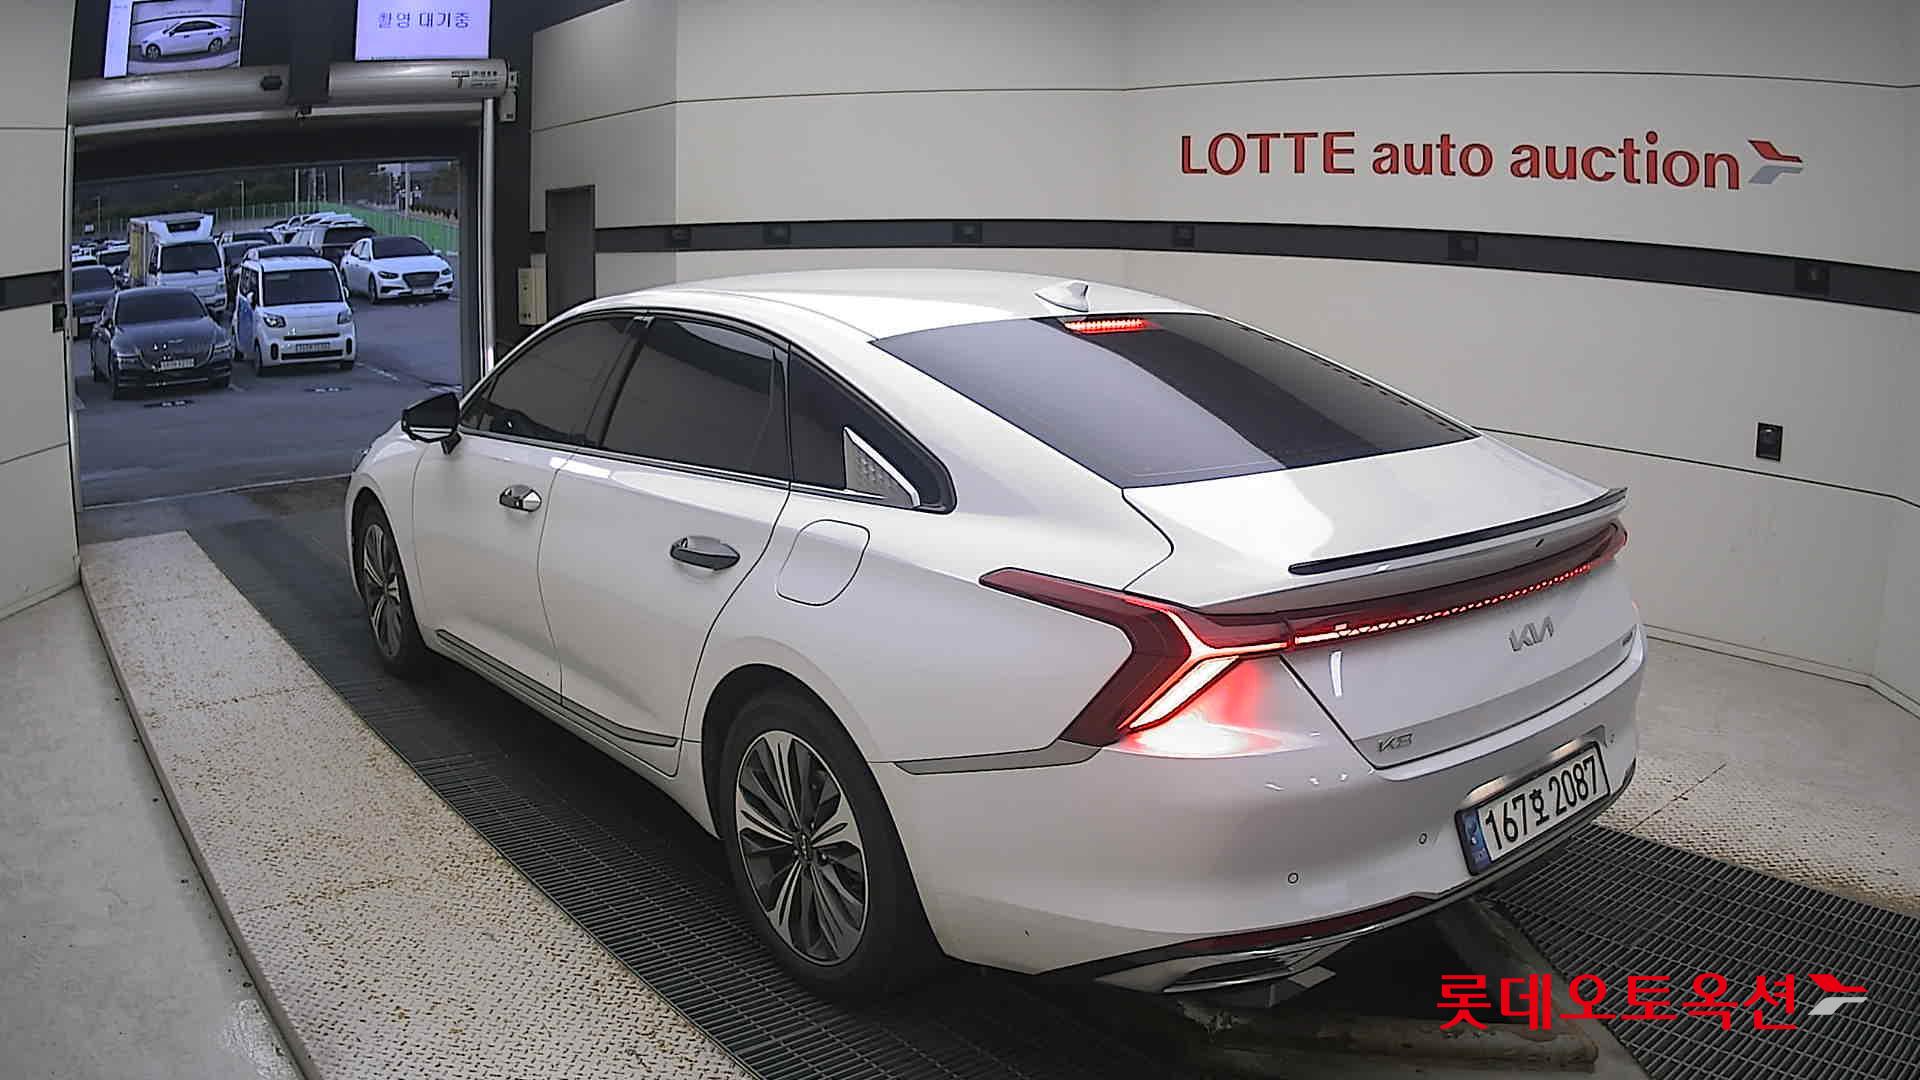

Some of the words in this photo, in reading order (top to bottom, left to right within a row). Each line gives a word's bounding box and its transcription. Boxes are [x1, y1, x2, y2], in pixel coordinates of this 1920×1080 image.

[418, 11, 471, 29] 대기중
[1180, 130, 1356, 176] LOTTE
[1372, 133, 1494, 178] auto
[1509, 130, 1741, 190] auction
[1377, 732, 1414, 754] K8
[1484, 788, 1551, 851] 167호
[1548, 757, 1600, 815] 2087
